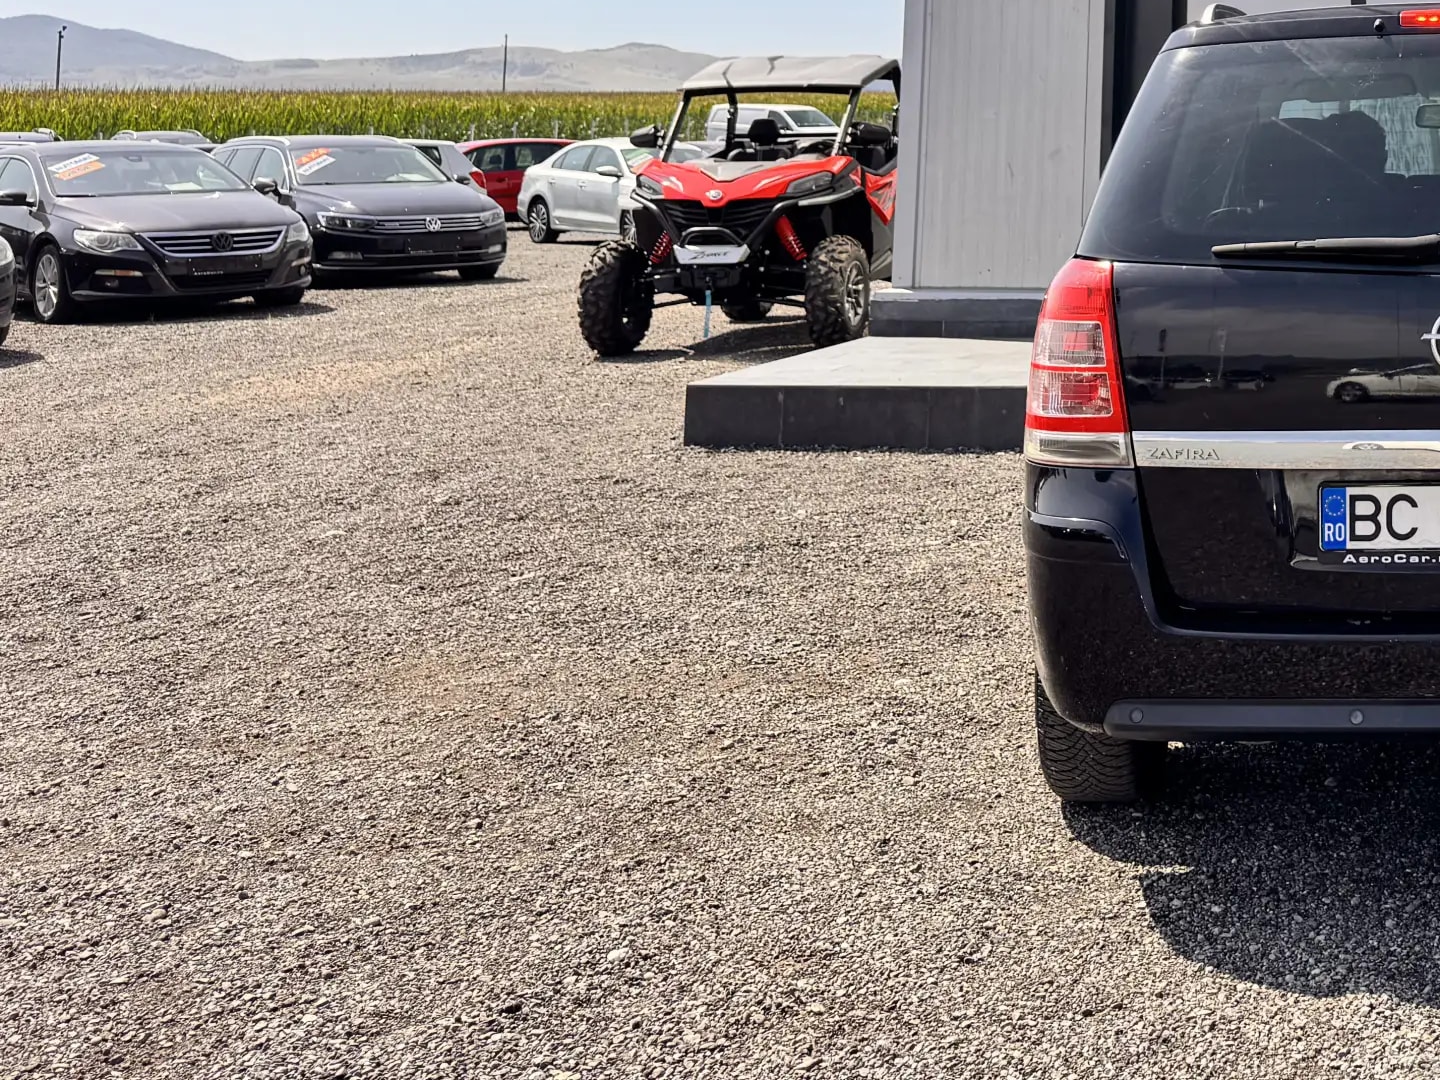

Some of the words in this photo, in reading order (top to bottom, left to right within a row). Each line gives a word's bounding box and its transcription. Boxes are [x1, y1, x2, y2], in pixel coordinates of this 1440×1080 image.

[1146, 447, 1220, 460] ZAFIRA
[1348, 493, 1419, 542] BC
[1324, 523, 1345, 542] RO
